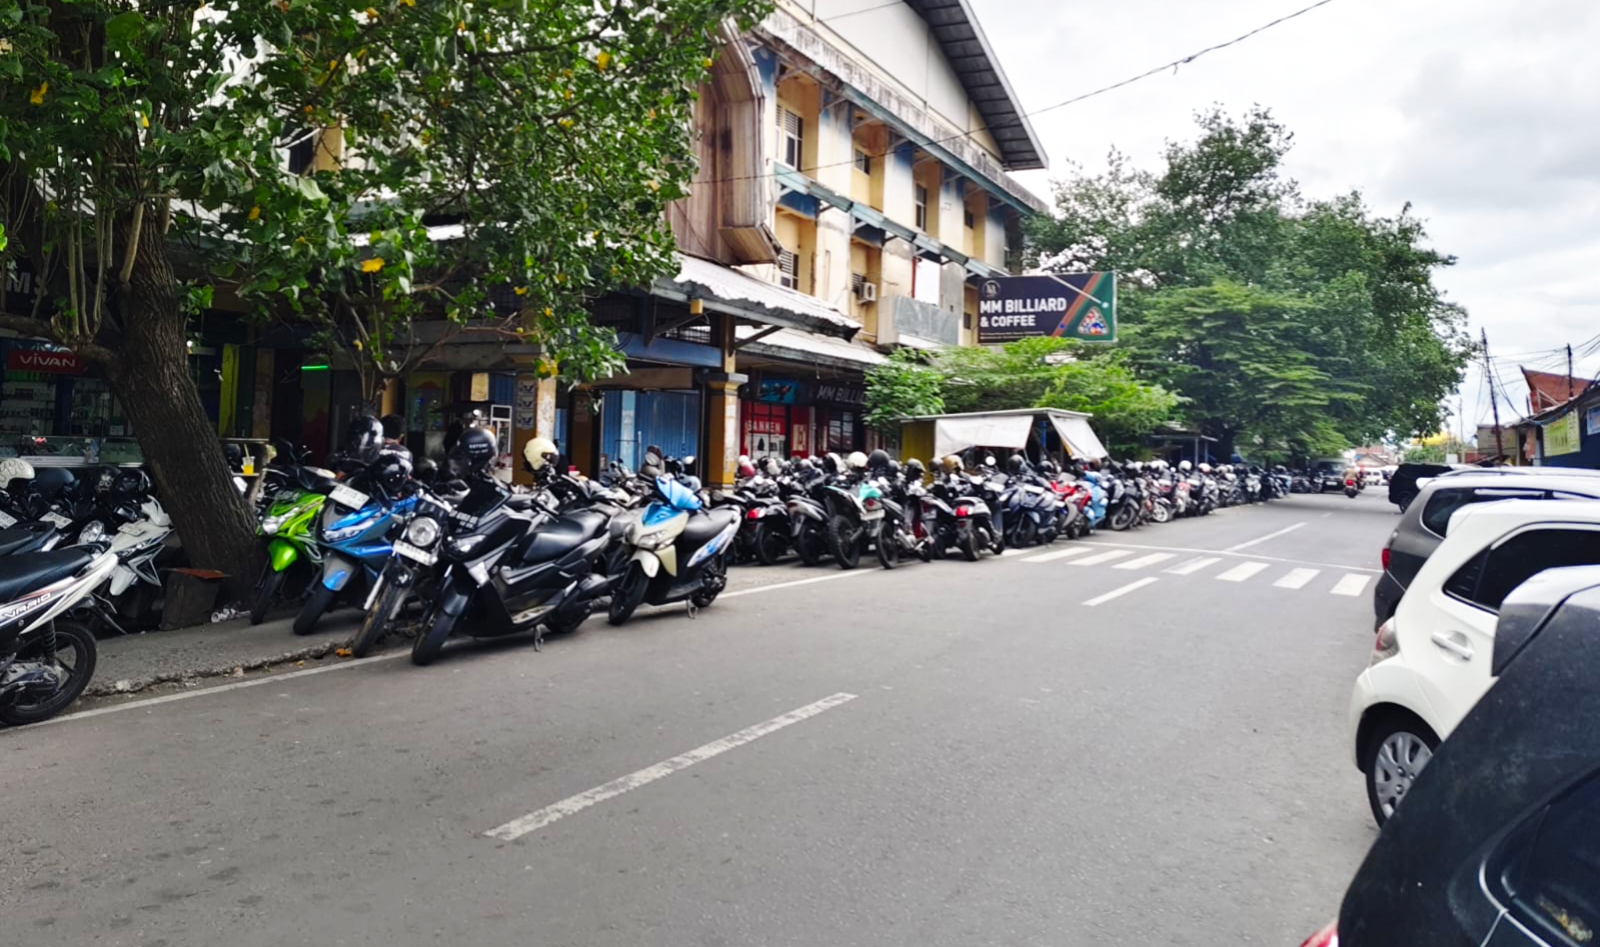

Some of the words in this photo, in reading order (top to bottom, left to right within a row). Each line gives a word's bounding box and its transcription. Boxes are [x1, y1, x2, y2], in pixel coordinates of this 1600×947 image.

[980, 300, 1002, 314] MM
[1005, 298, 1067, 313] BILLIARD
[980, 316, 989, 327] &
[991, 315, 1036, 327] COFFEE
[2, 592, 51, 619] VARIO
